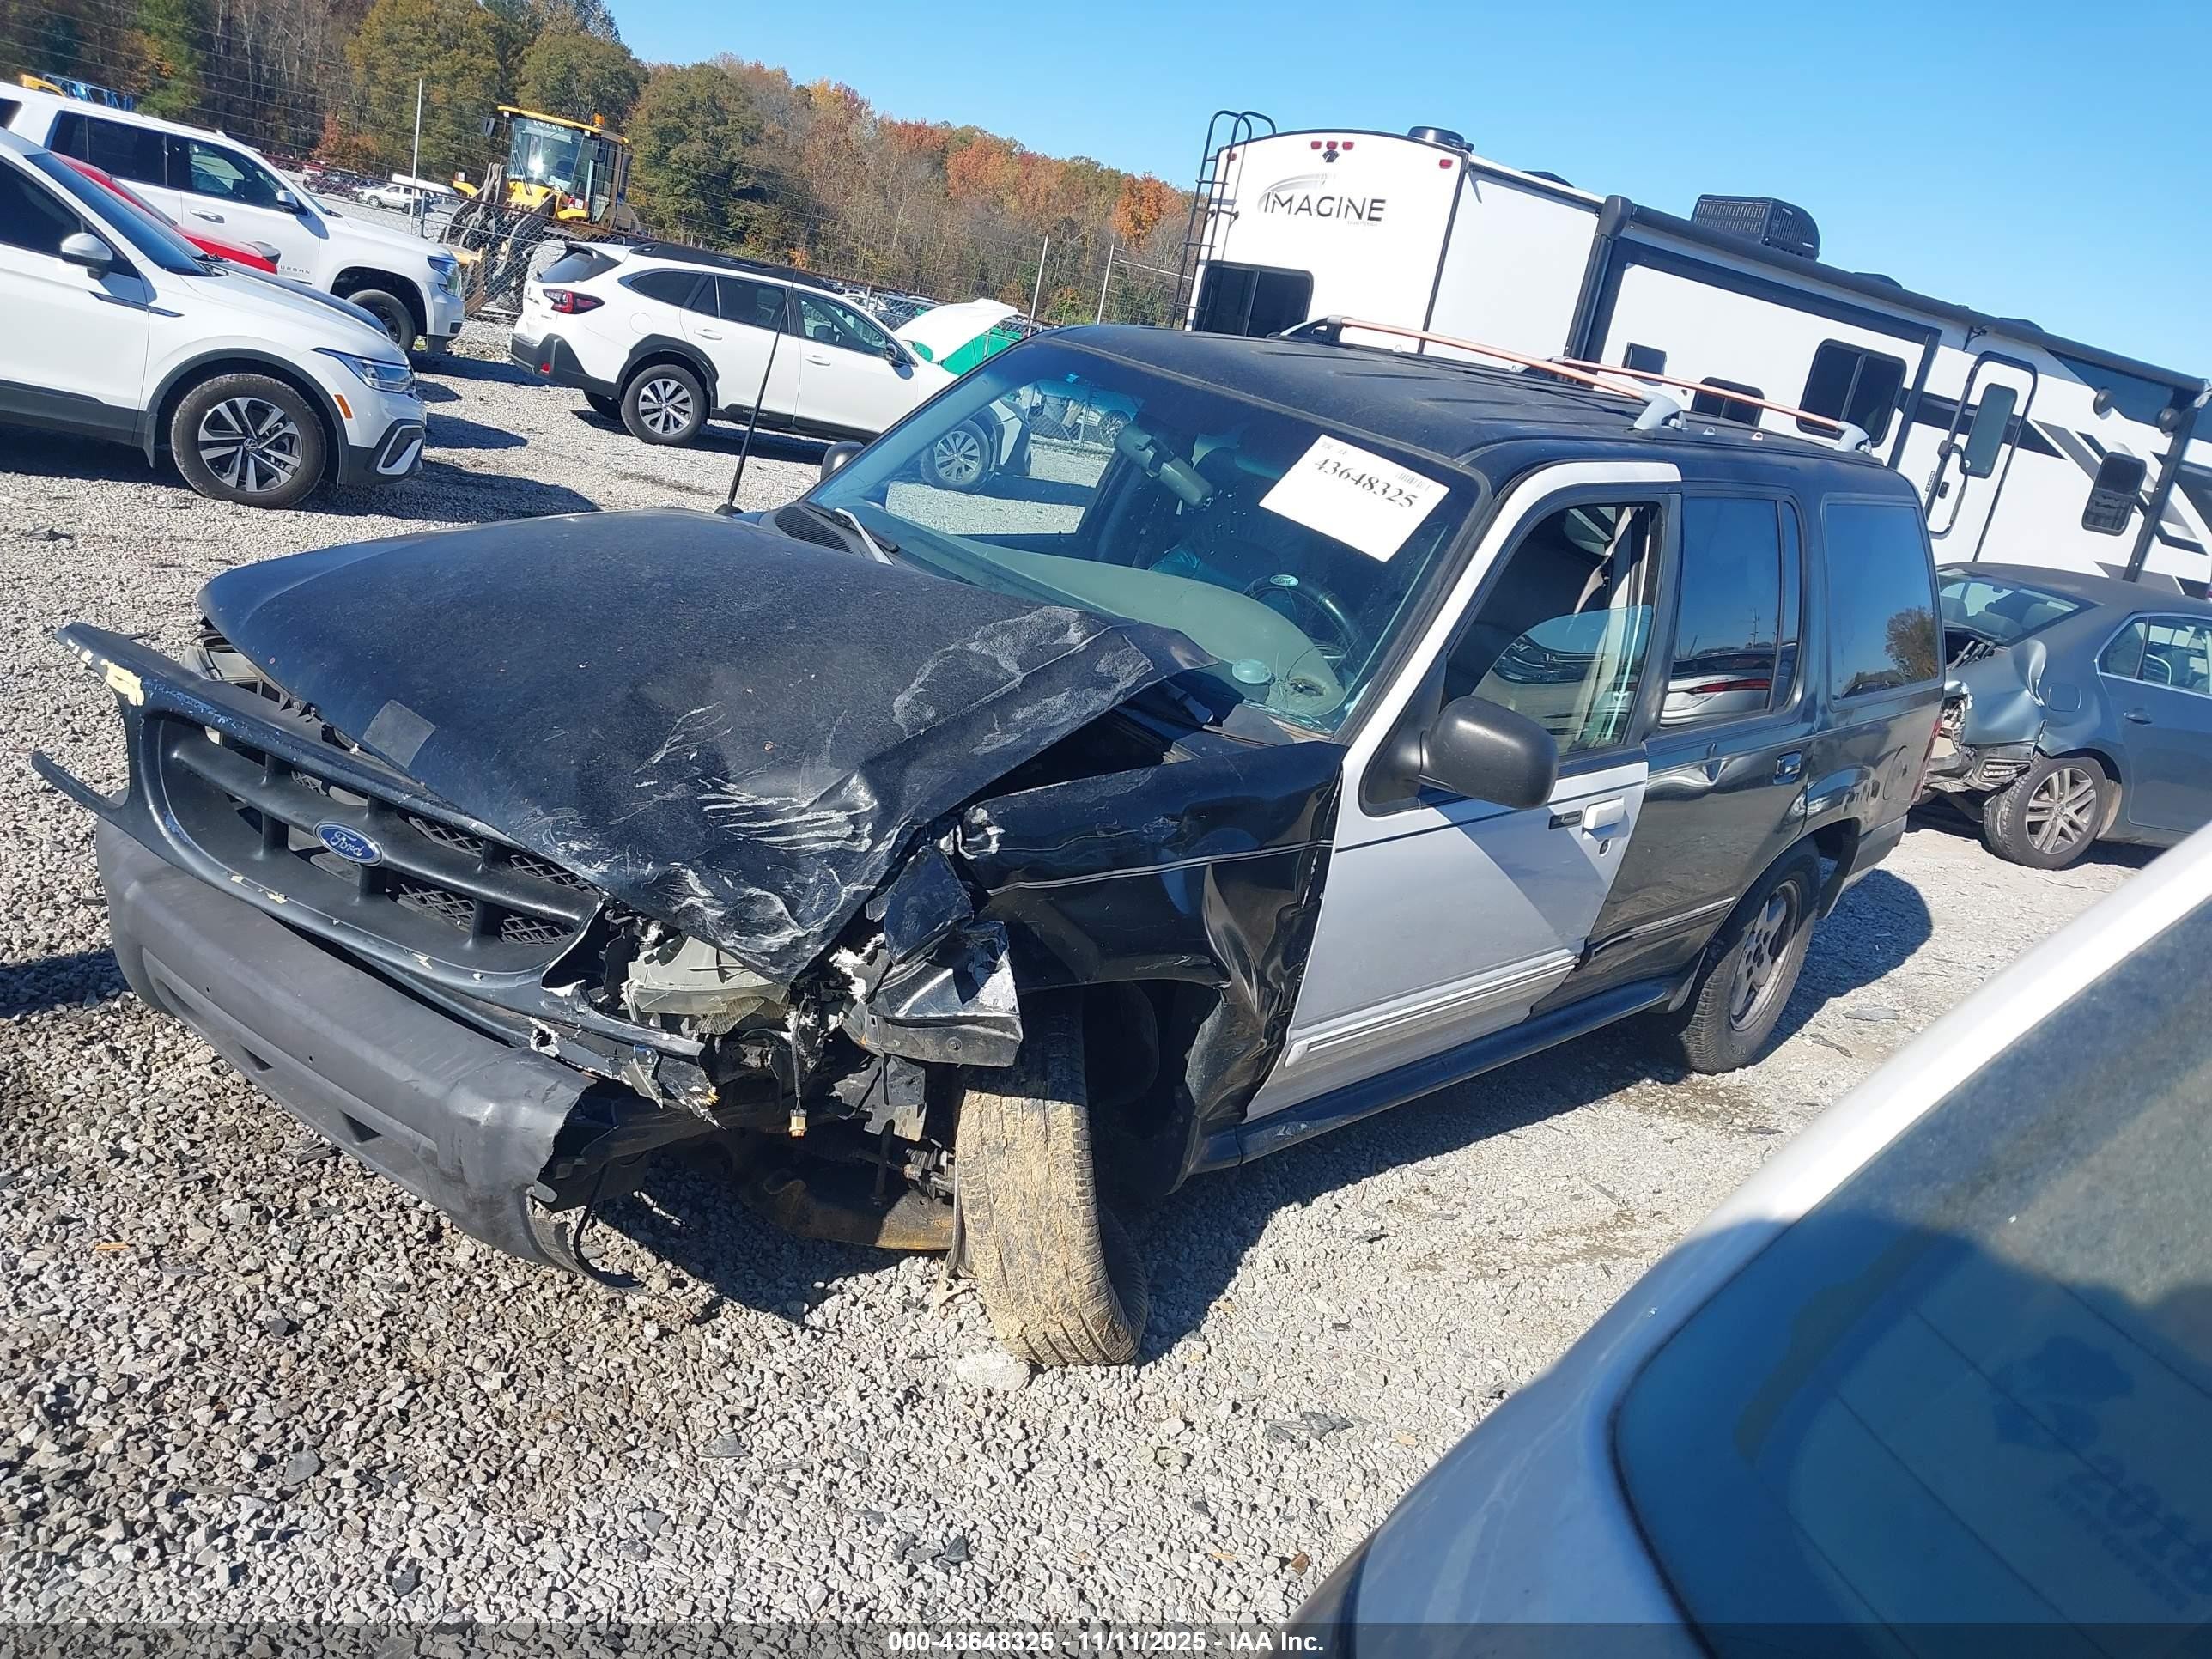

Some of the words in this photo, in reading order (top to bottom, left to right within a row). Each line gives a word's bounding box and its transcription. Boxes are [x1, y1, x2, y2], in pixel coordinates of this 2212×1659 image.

[532, 121, 565, 131] VOLVO
[1263, 191, 1387, 222] IMAGINE
[1315, 458, 1419, 508] 43648325
[329, 830, 364, 857] Ford
